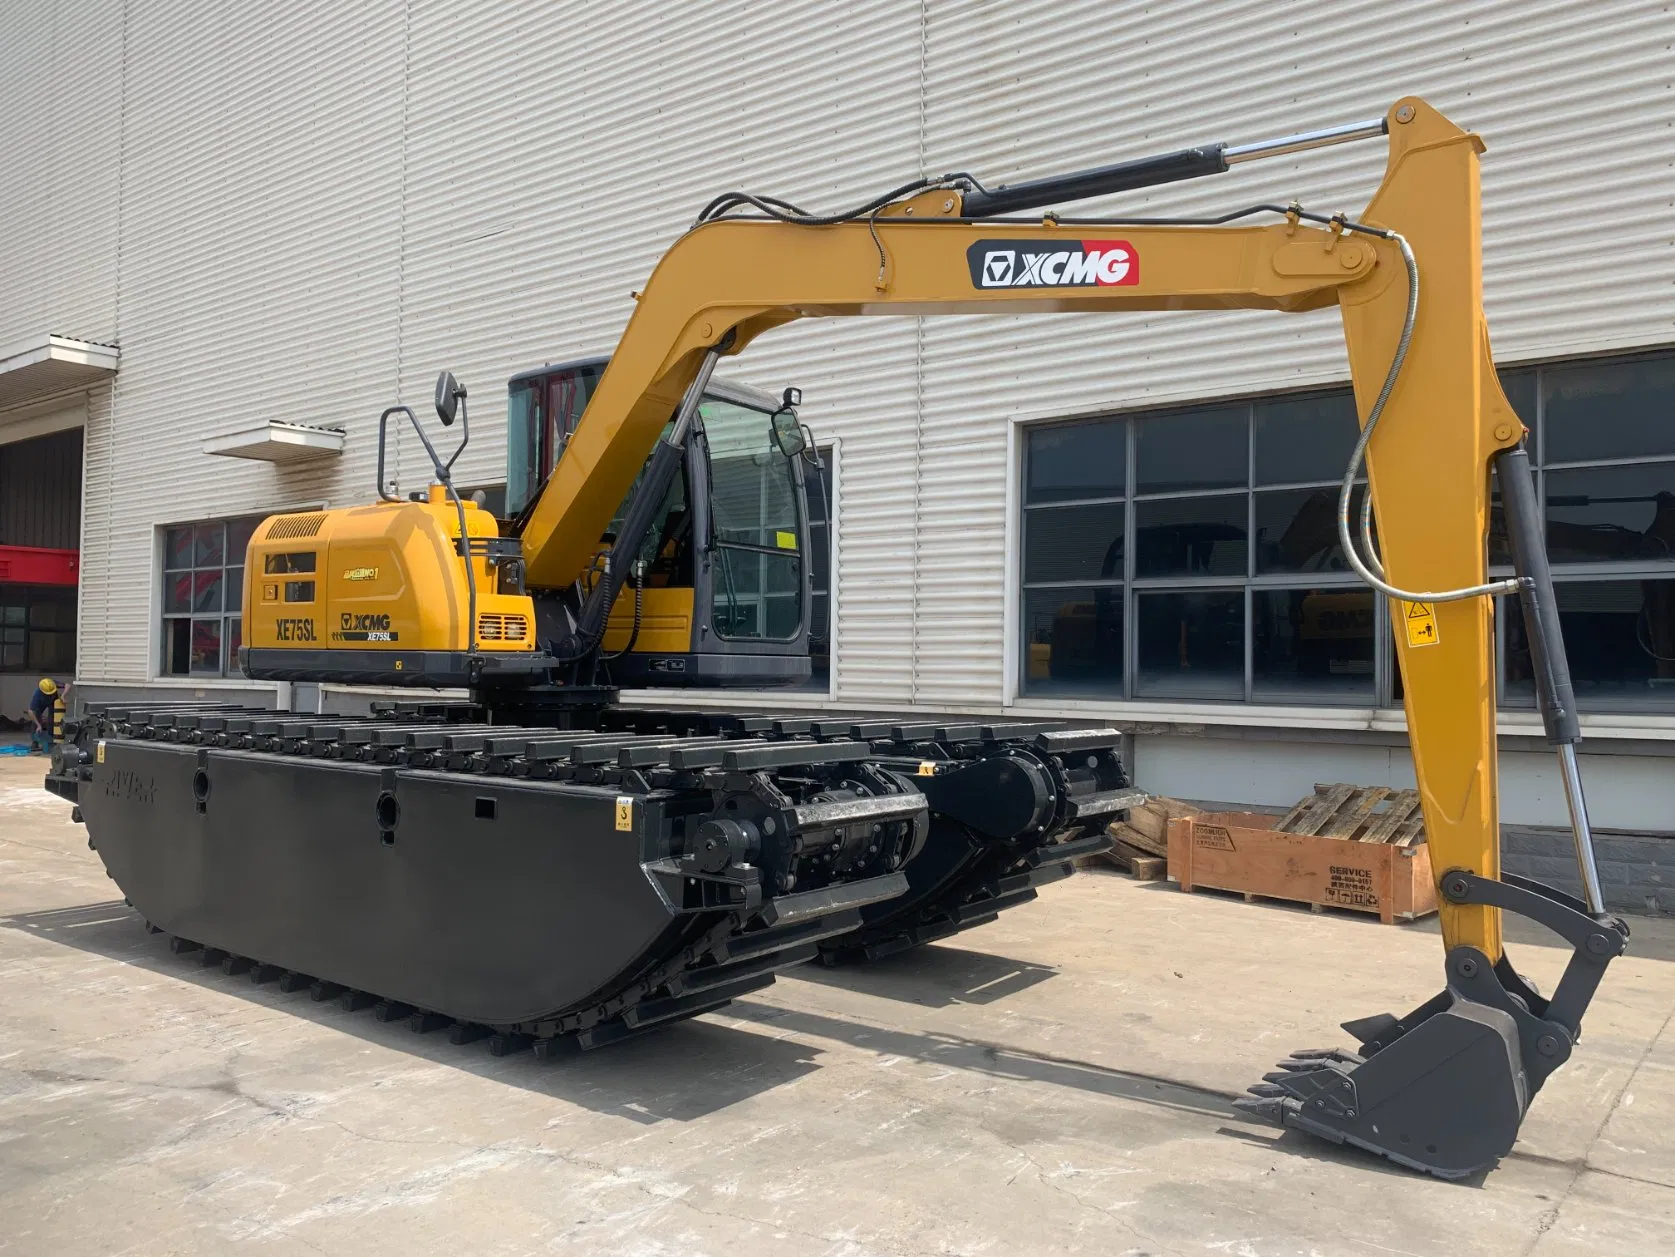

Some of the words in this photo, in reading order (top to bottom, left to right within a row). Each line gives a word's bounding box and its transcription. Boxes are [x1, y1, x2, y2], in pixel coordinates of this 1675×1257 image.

[1011, 249, 1130, 286] XCMG
[276, 619, 317, 641] XE75SL
[353, 614, 391, 631] XCMG
[367, 632, 392, 641] XE75SL
[1329, 866, 1372, 878] SERVICE
